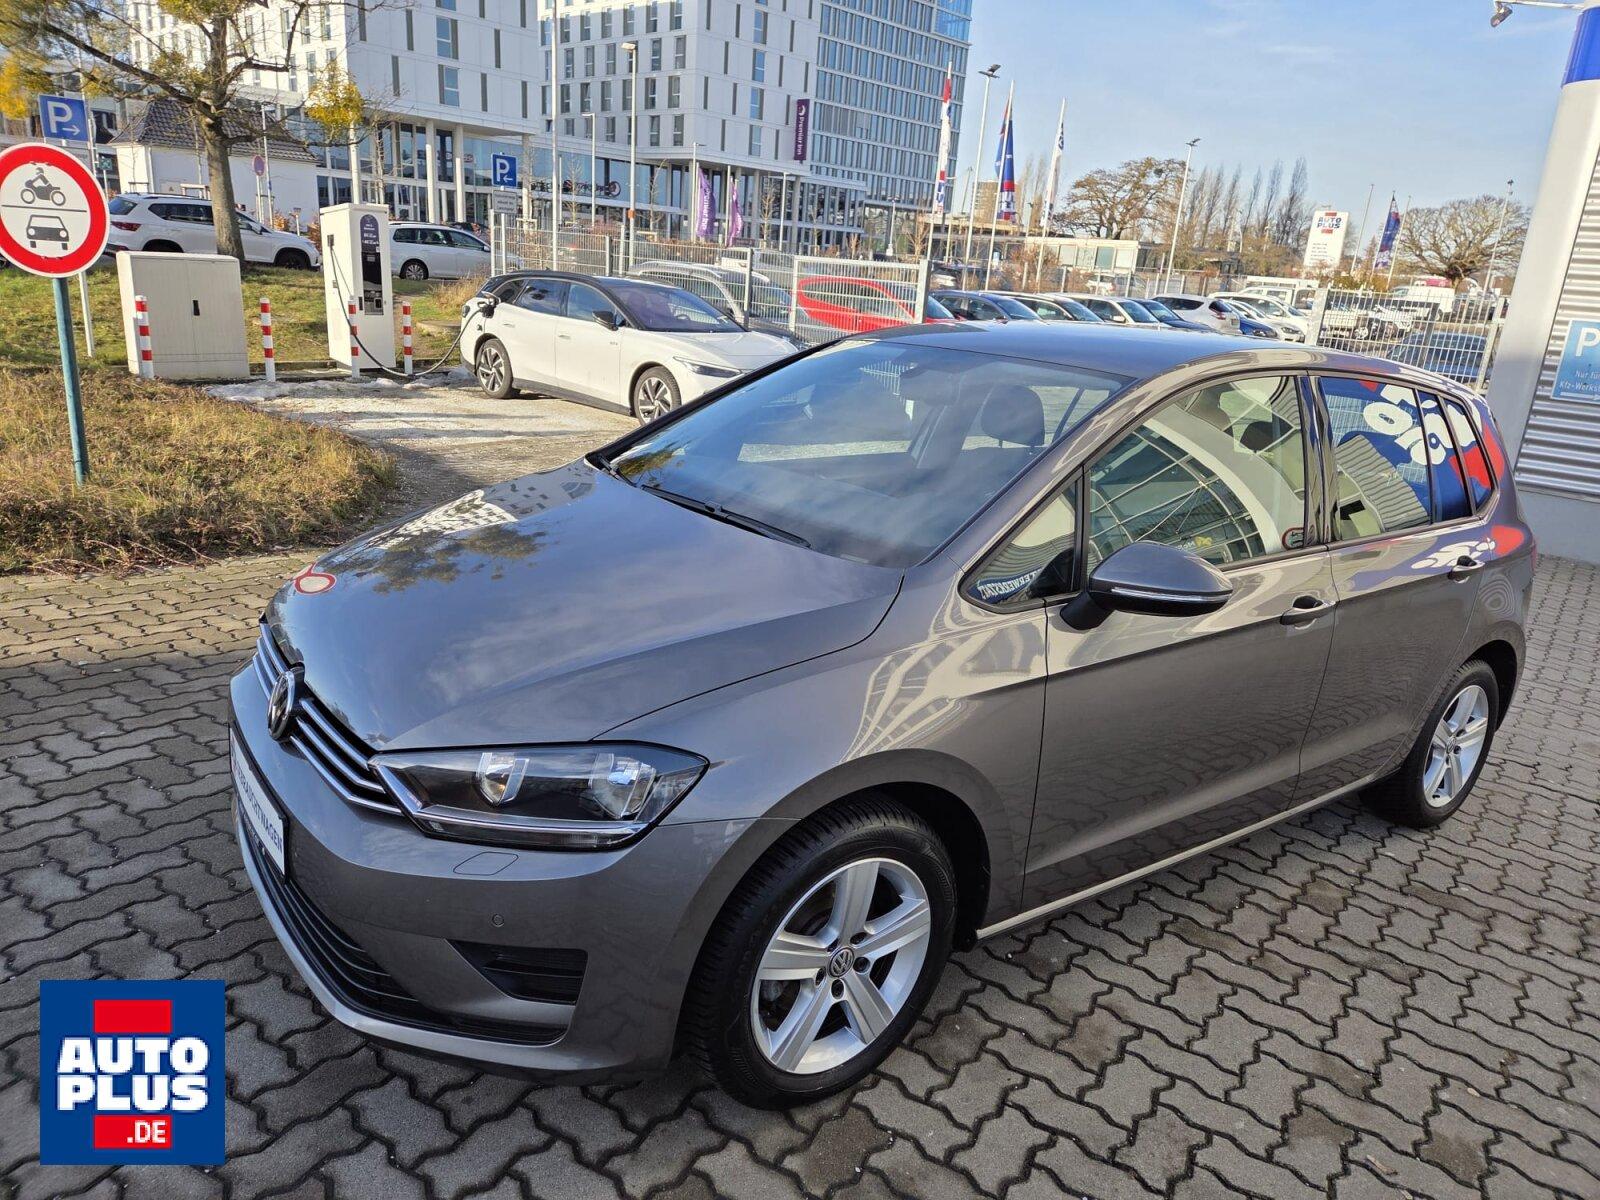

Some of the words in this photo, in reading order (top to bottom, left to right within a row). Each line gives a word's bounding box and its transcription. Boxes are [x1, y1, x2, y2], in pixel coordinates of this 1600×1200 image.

[47, 100, 73, 133] P
[797, 116, 805, 142] Premier
[796, 144, 804, 155] Inn
[496, 158, 510, 182] P
[1318, 216, 1342, 224] AUTO
[1575, 327, 1600, 357] P
